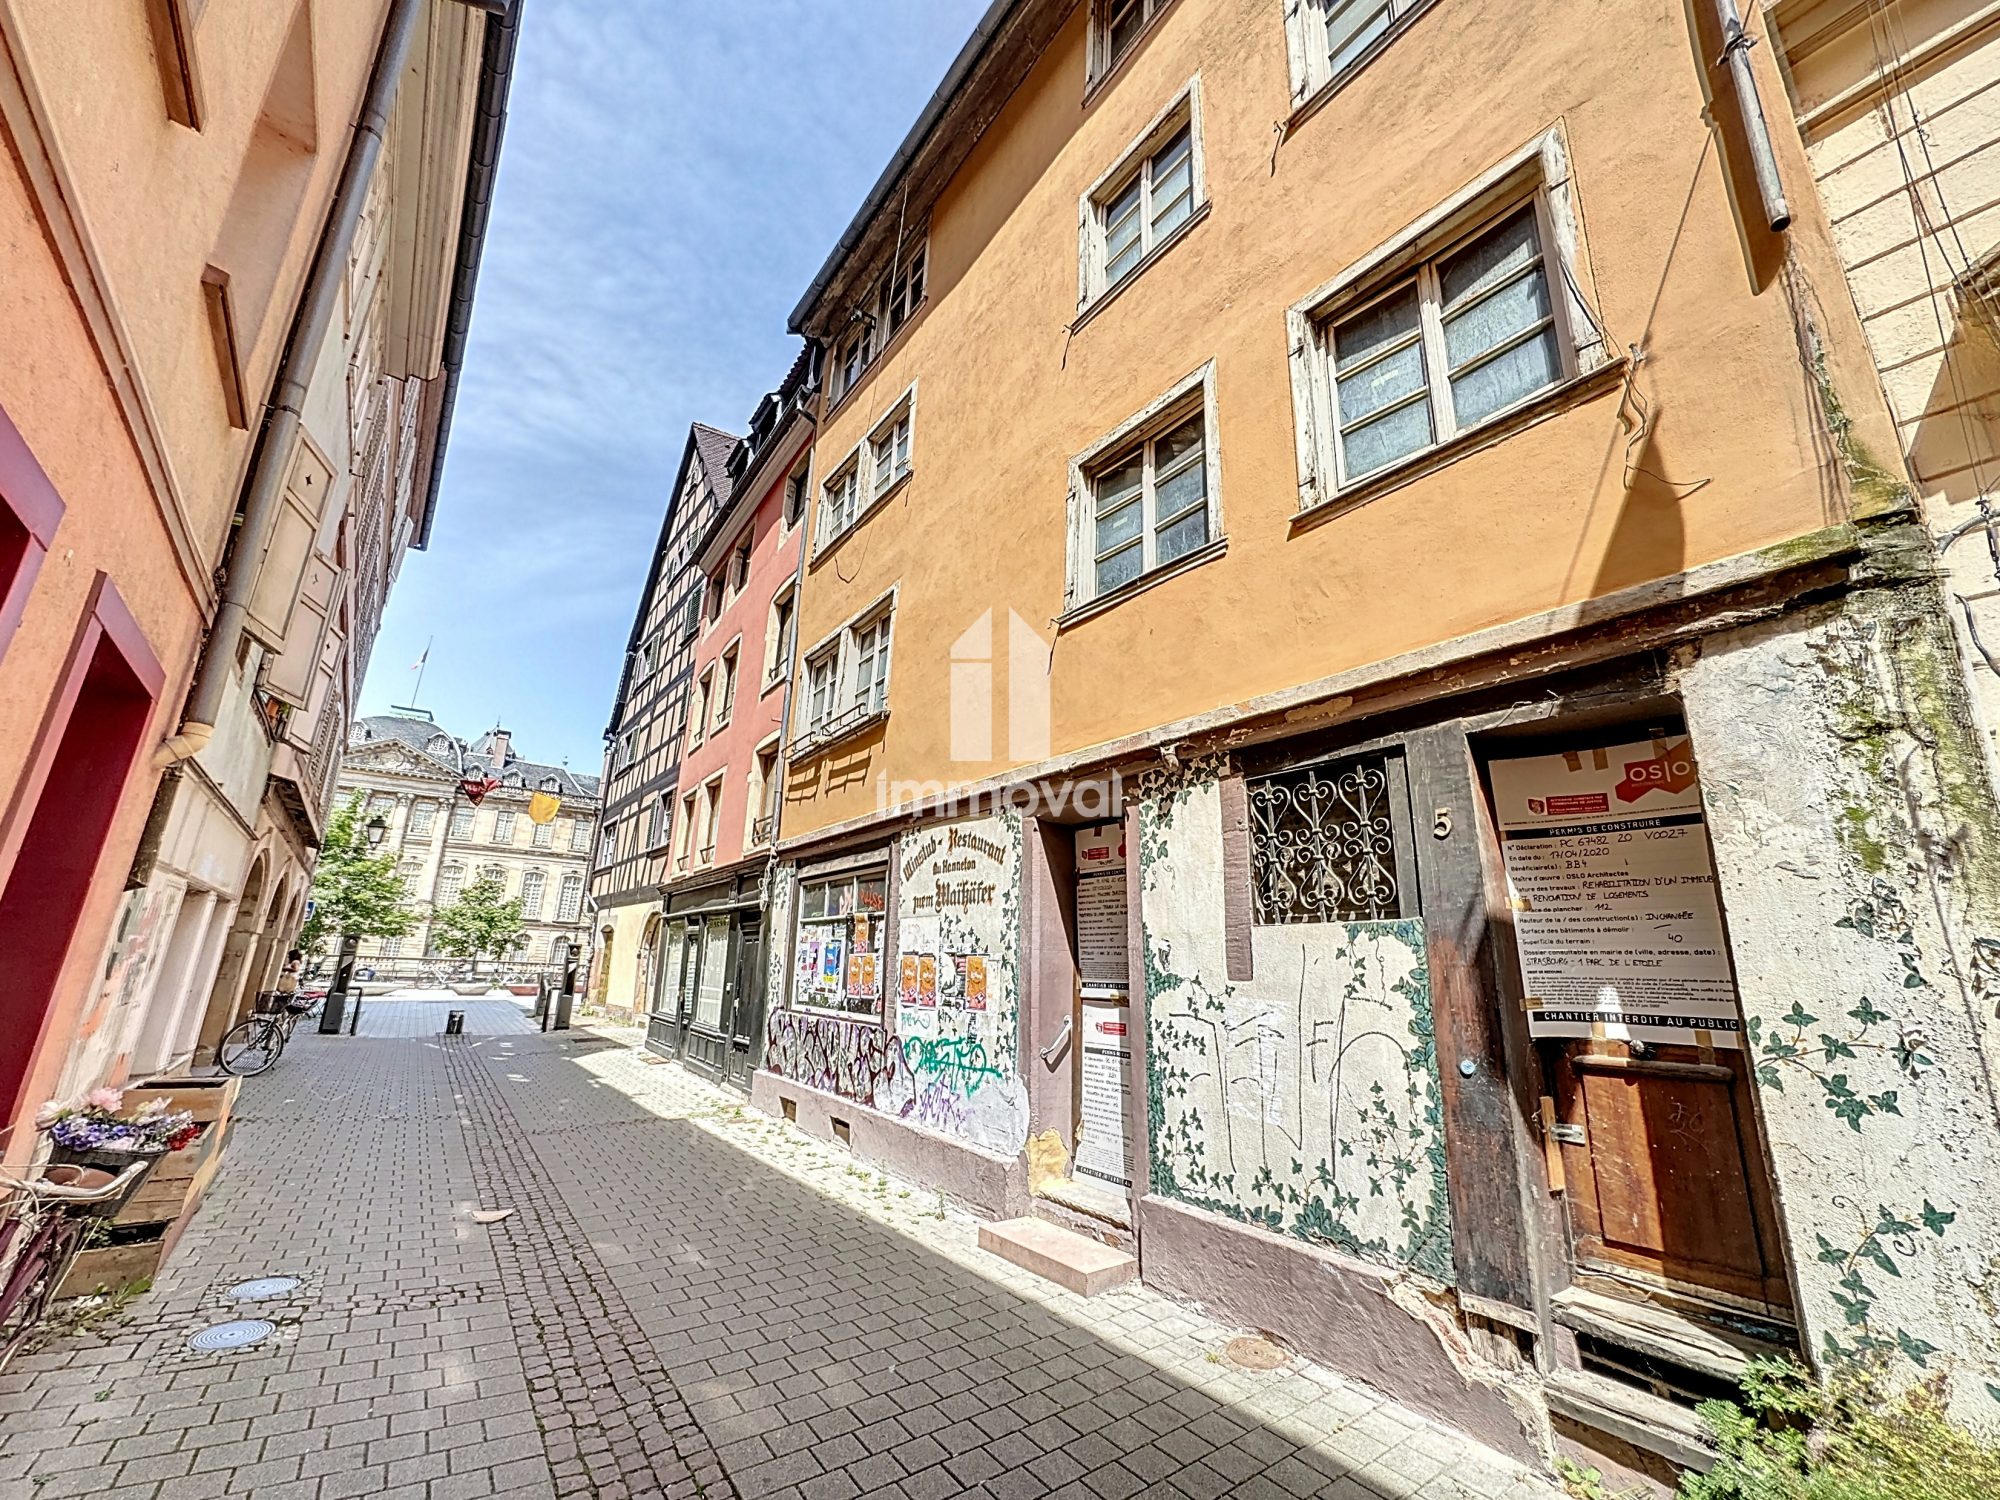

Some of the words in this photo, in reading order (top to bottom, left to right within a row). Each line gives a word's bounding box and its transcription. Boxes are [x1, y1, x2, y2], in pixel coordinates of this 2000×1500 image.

[1433, 806, 1452, 841] 5
[1586, 825, 1598, 833] DE
[1601, 819, 1661, 832] CONSTRUIRE
[947, 825, 1007, 866] Restaurant
[1560, 839, 1574, 848] PC
[1577, 836, 1609, 847] 67482
[1618, 833, 1633, 843] 20
[1549, 847, 1610, 859] 17/04/2020
[1587, 870, 1629, 879] Architectes
[1549, 884, 1576, 892] travaux
[1586, 893, 1597, 901] DE
[1667, 933, 1683, 943] 40
[1525, 957, 1569, 967] STRASBOURG
[1609, 959, 1620, 967] DE
[1544, 1011, 1600, 1023] CHANTIER
[1604, 1013, 1660, 1025] INTERDIT
[1667, 1017, 1683, 1027] AU
[1689, 1018, 1738, 1030] PUBLIC
